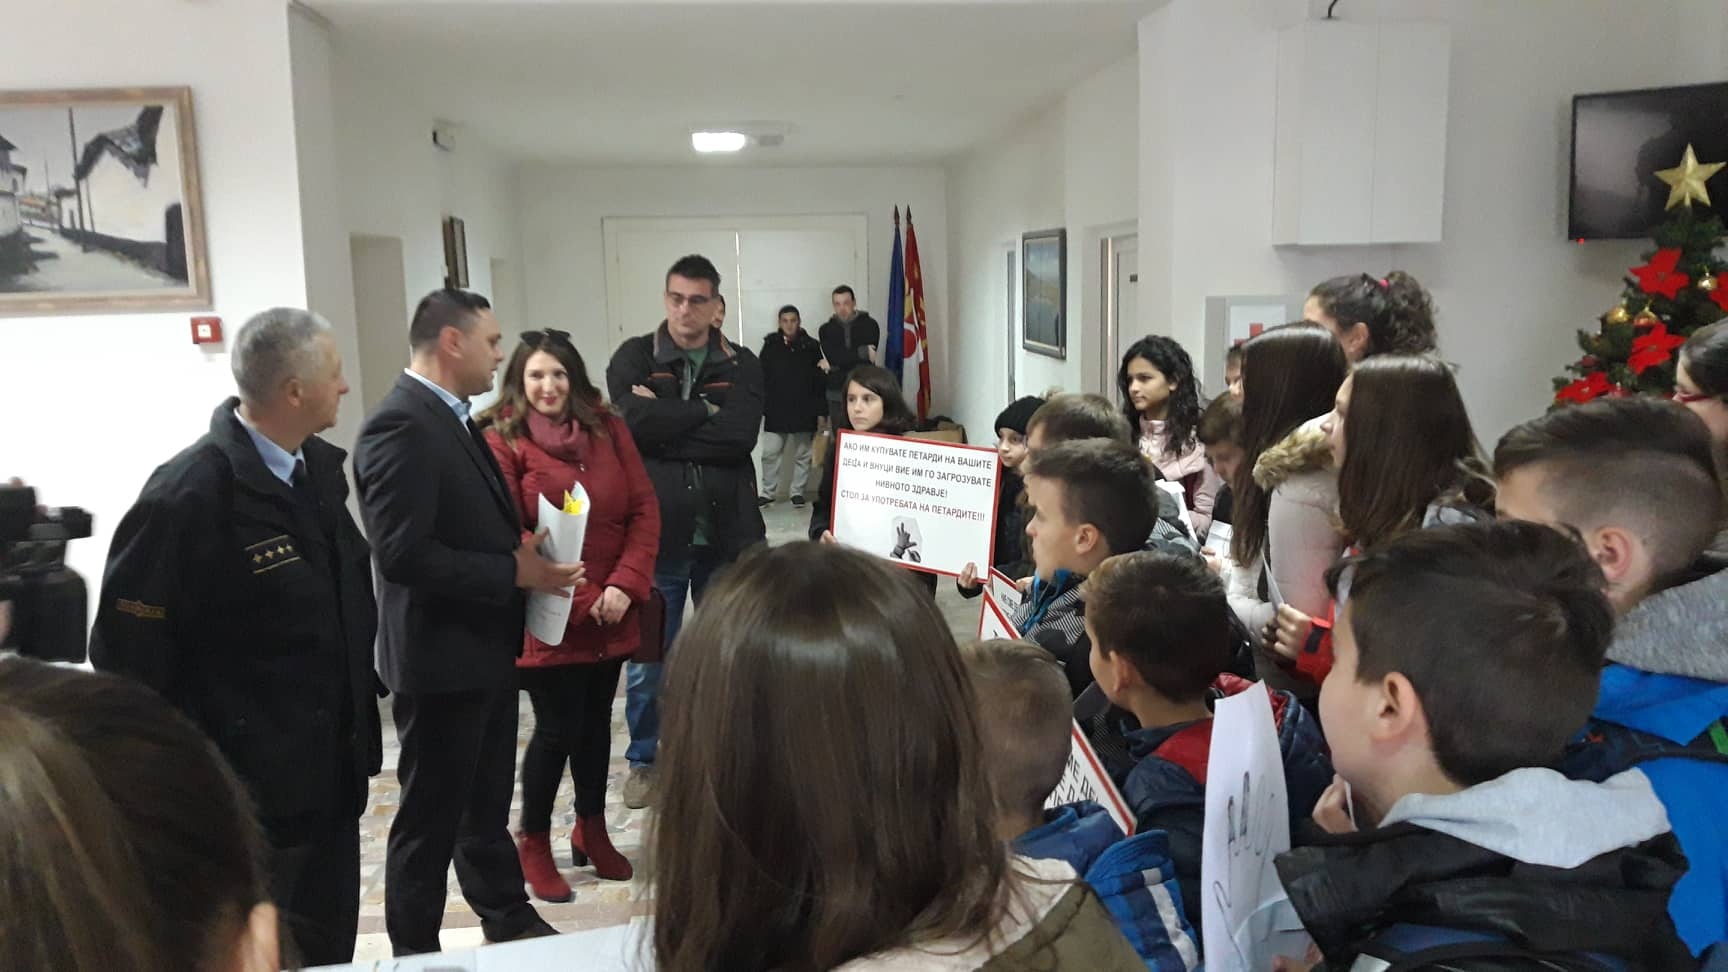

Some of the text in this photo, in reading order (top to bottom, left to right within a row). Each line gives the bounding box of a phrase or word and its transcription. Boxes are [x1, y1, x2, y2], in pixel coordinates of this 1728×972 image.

[843, 441, 992, 469] АКО ИМ КУПУВАТЕ ПЕТАРДИ НА ВАШИТЕ
[869, 461, 894, 473] ВНУЦИ
[895, 465, 910, 475] ВИЕ
[912, 468, 923, 476] ИМ
[925, 469, 935, 478] ГО
[937, 471, 992, 487] ЗАГРОЗУВАТЕ
[875, 480, 948, 498] НИВНОТО ЗДРАВЈЕ!
[841, 489, 860, 499] СТОП
[872, 495, 917, 511] УПОТРЕБАТА
[919, 503, 930, 512] НА
[932, 504, 985, 521] ПЕТАРДИТЕ!!!
